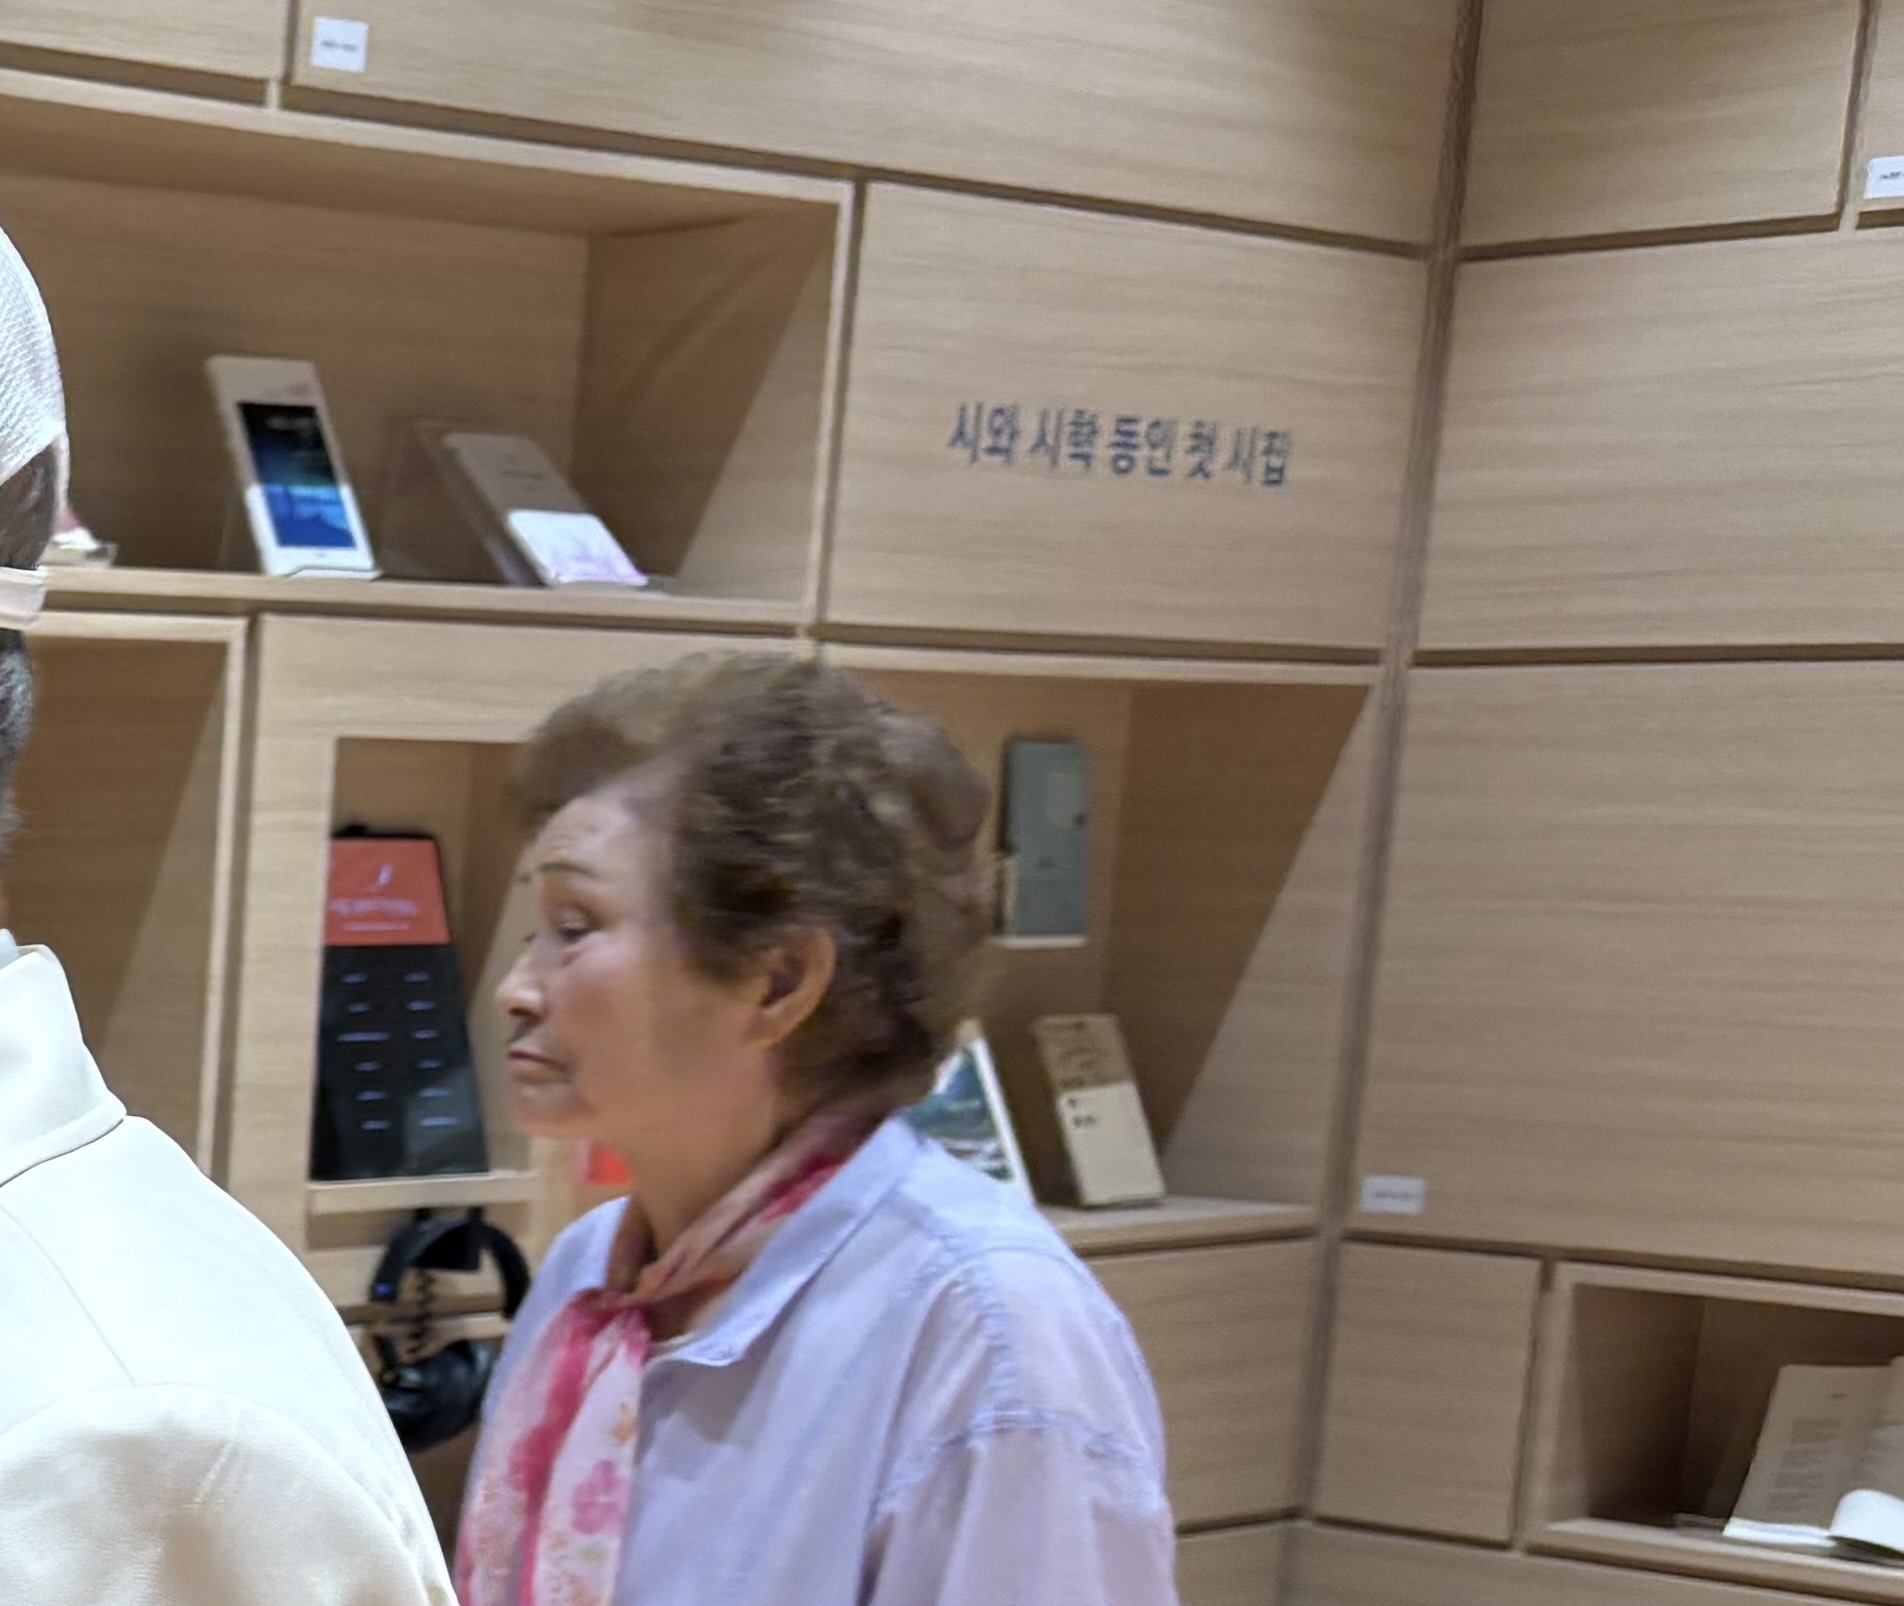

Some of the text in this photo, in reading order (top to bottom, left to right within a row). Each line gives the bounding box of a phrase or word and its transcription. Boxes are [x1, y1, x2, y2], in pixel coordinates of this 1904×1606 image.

[948, 402, 1290, 486] 시와 시학 동인 첫 시집
